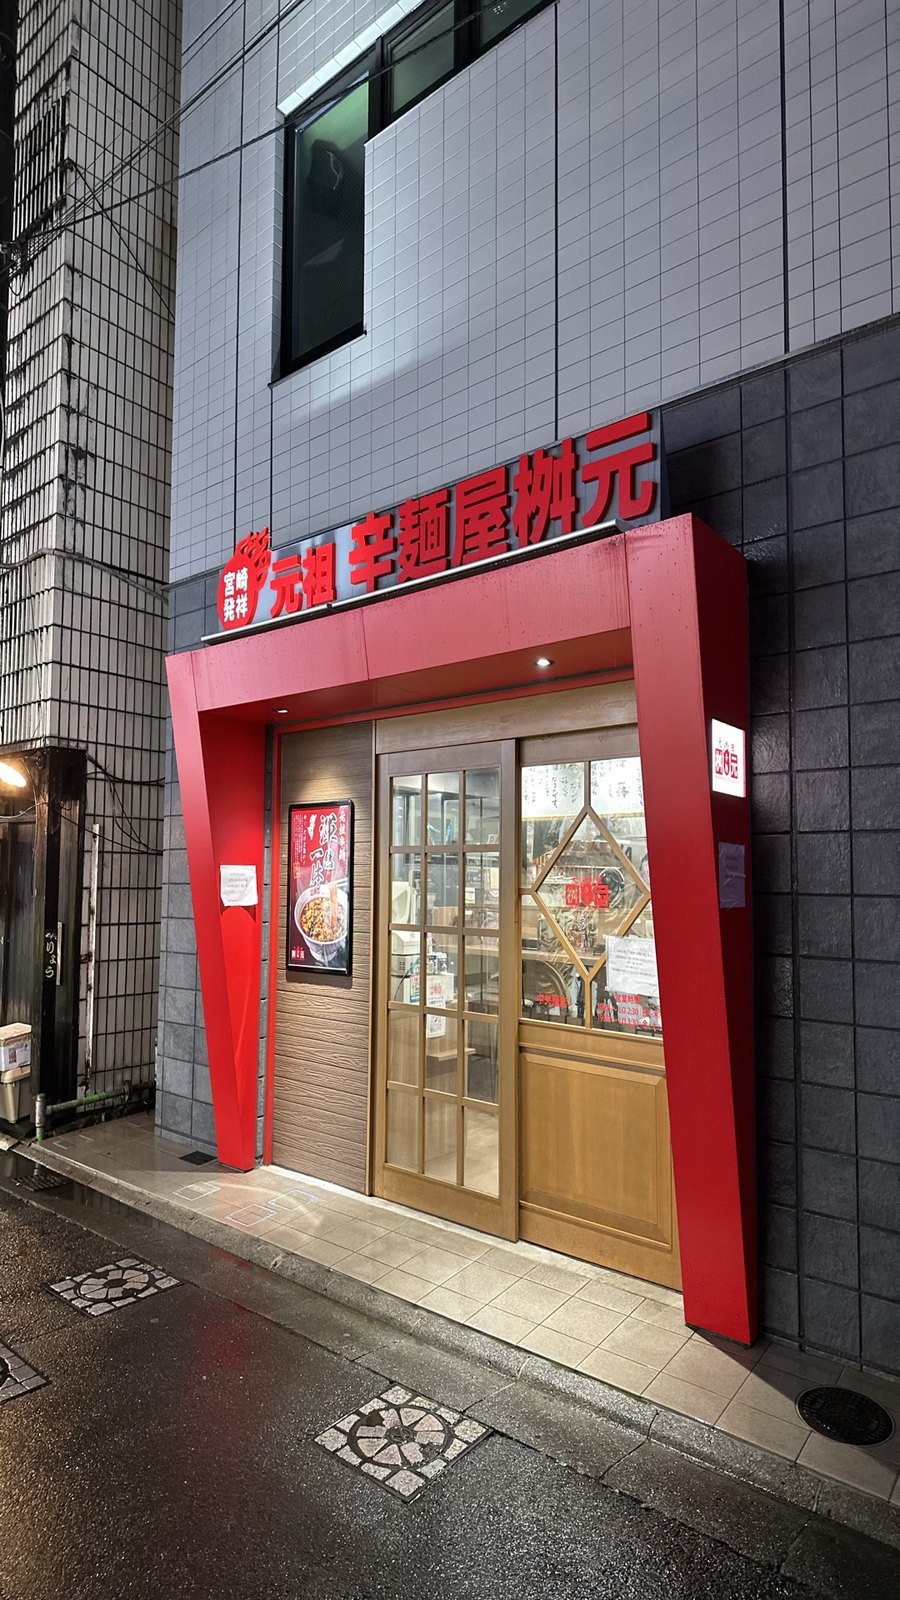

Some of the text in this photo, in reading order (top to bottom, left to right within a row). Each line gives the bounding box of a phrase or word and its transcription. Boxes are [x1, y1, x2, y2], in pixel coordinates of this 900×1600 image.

[270, 411, 657, 618] 元祖 辛麺屋桝元
[223, 566, 249, 597] 宮崎
[223, 592, 249, 623] 発祥
